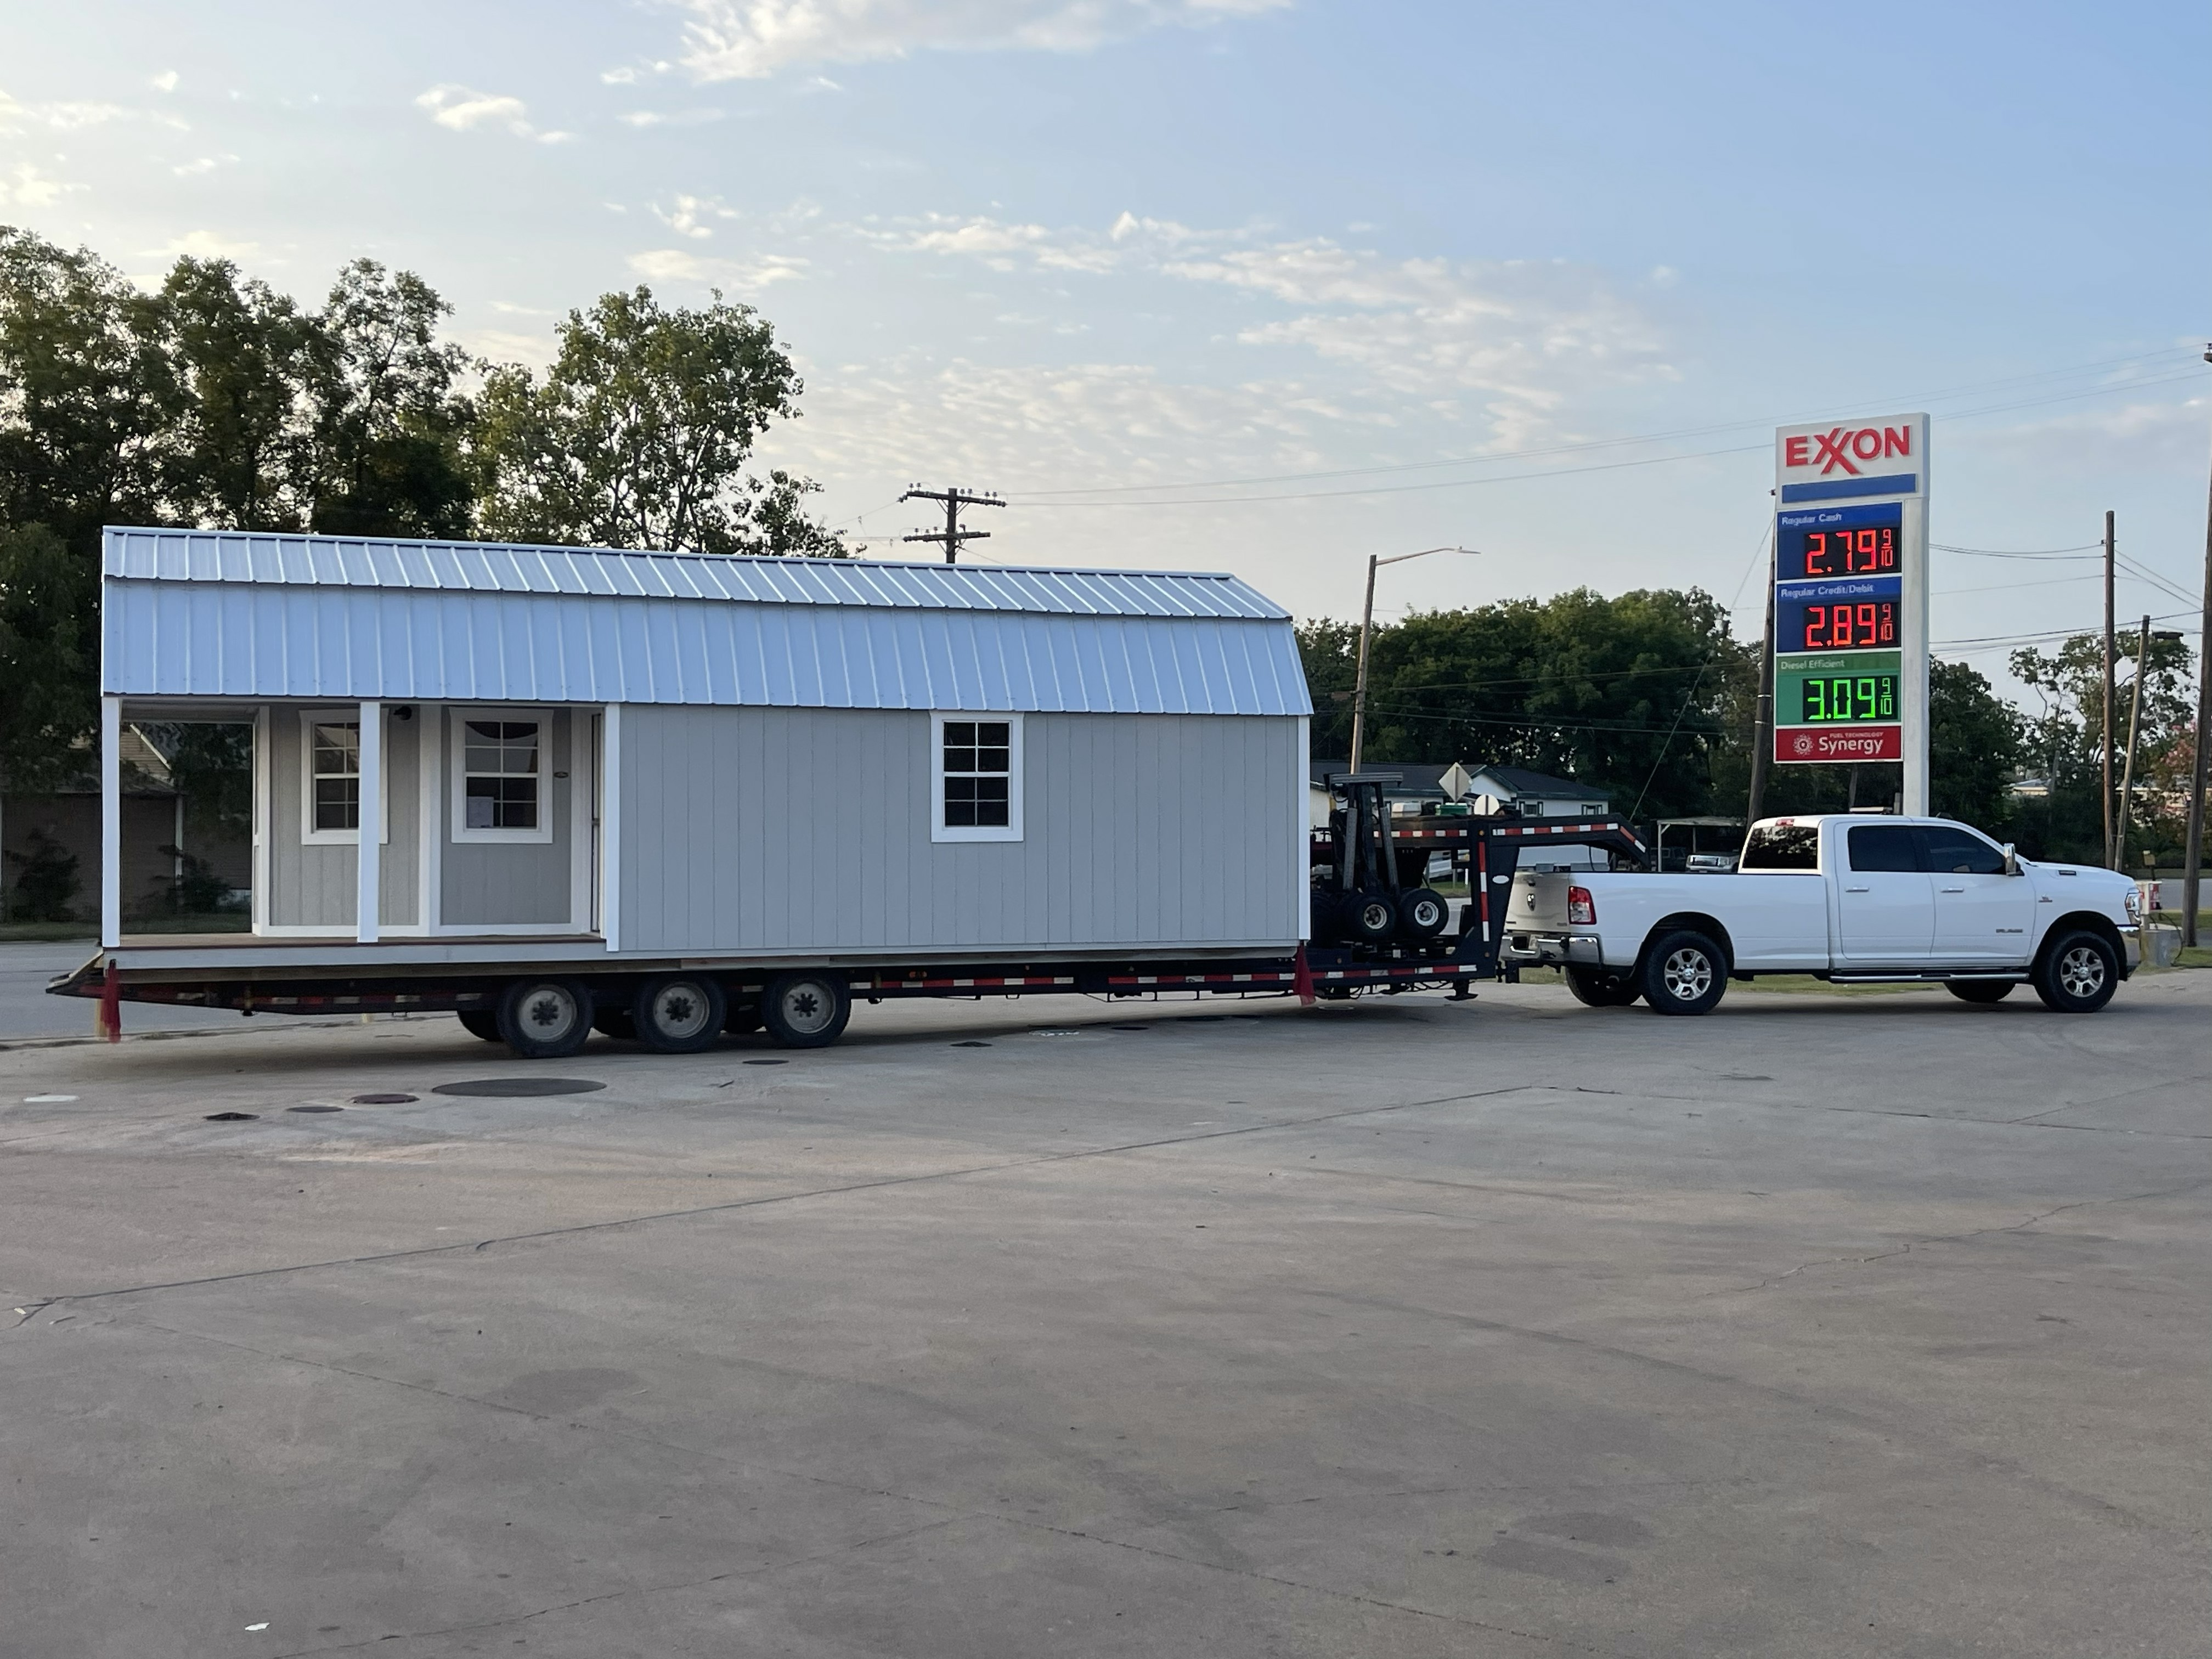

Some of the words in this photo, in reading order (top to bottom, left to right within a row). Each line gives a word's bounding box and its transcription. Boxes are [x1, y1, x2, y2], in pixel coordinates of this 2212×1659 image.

[1786, 425, 1910, 475] EXXON
[1781, 516, 1815, 526] Regular
[1819, 513, 1842, 522] Cash
[1805, 529, 1877, 574] 2.79
[1781, 588, 1815, 599] Regular
[1818, 584, 1875, 595] Credit/Debit
[1806, 603, 1877, 647] 2.89
[1781, 660, 1807, 669] Diesel
[1809, 659, 1846, 669] Efficient
[1807, 678, 1876, 720] 3.09
[1819, 736, 1884, 755] Synergy
